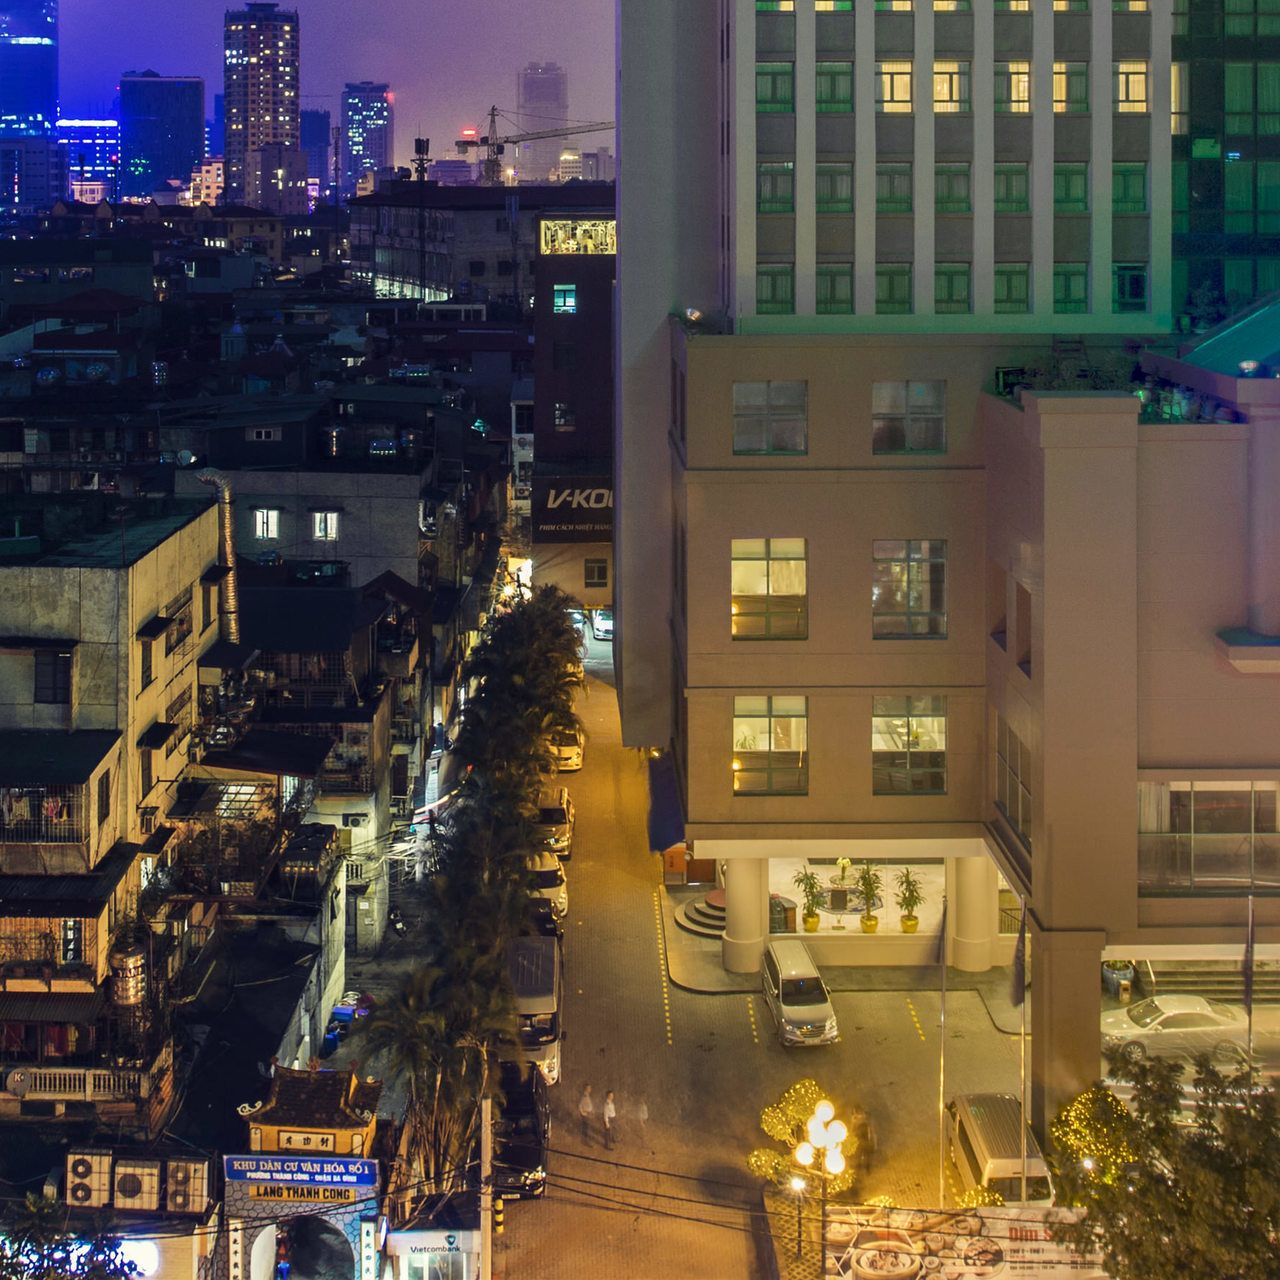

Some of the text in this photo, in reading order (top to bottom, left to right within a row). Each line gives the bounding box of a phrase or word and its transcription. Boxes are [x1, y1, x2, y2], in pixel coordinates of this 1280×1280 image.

[233, 1160, 257, 1170] KHU
[323, 1162, 346, 1173] HÓA
[362, 1165, 369, 1174] 1
[410, 1244, 461, 1254] Vietcombank
